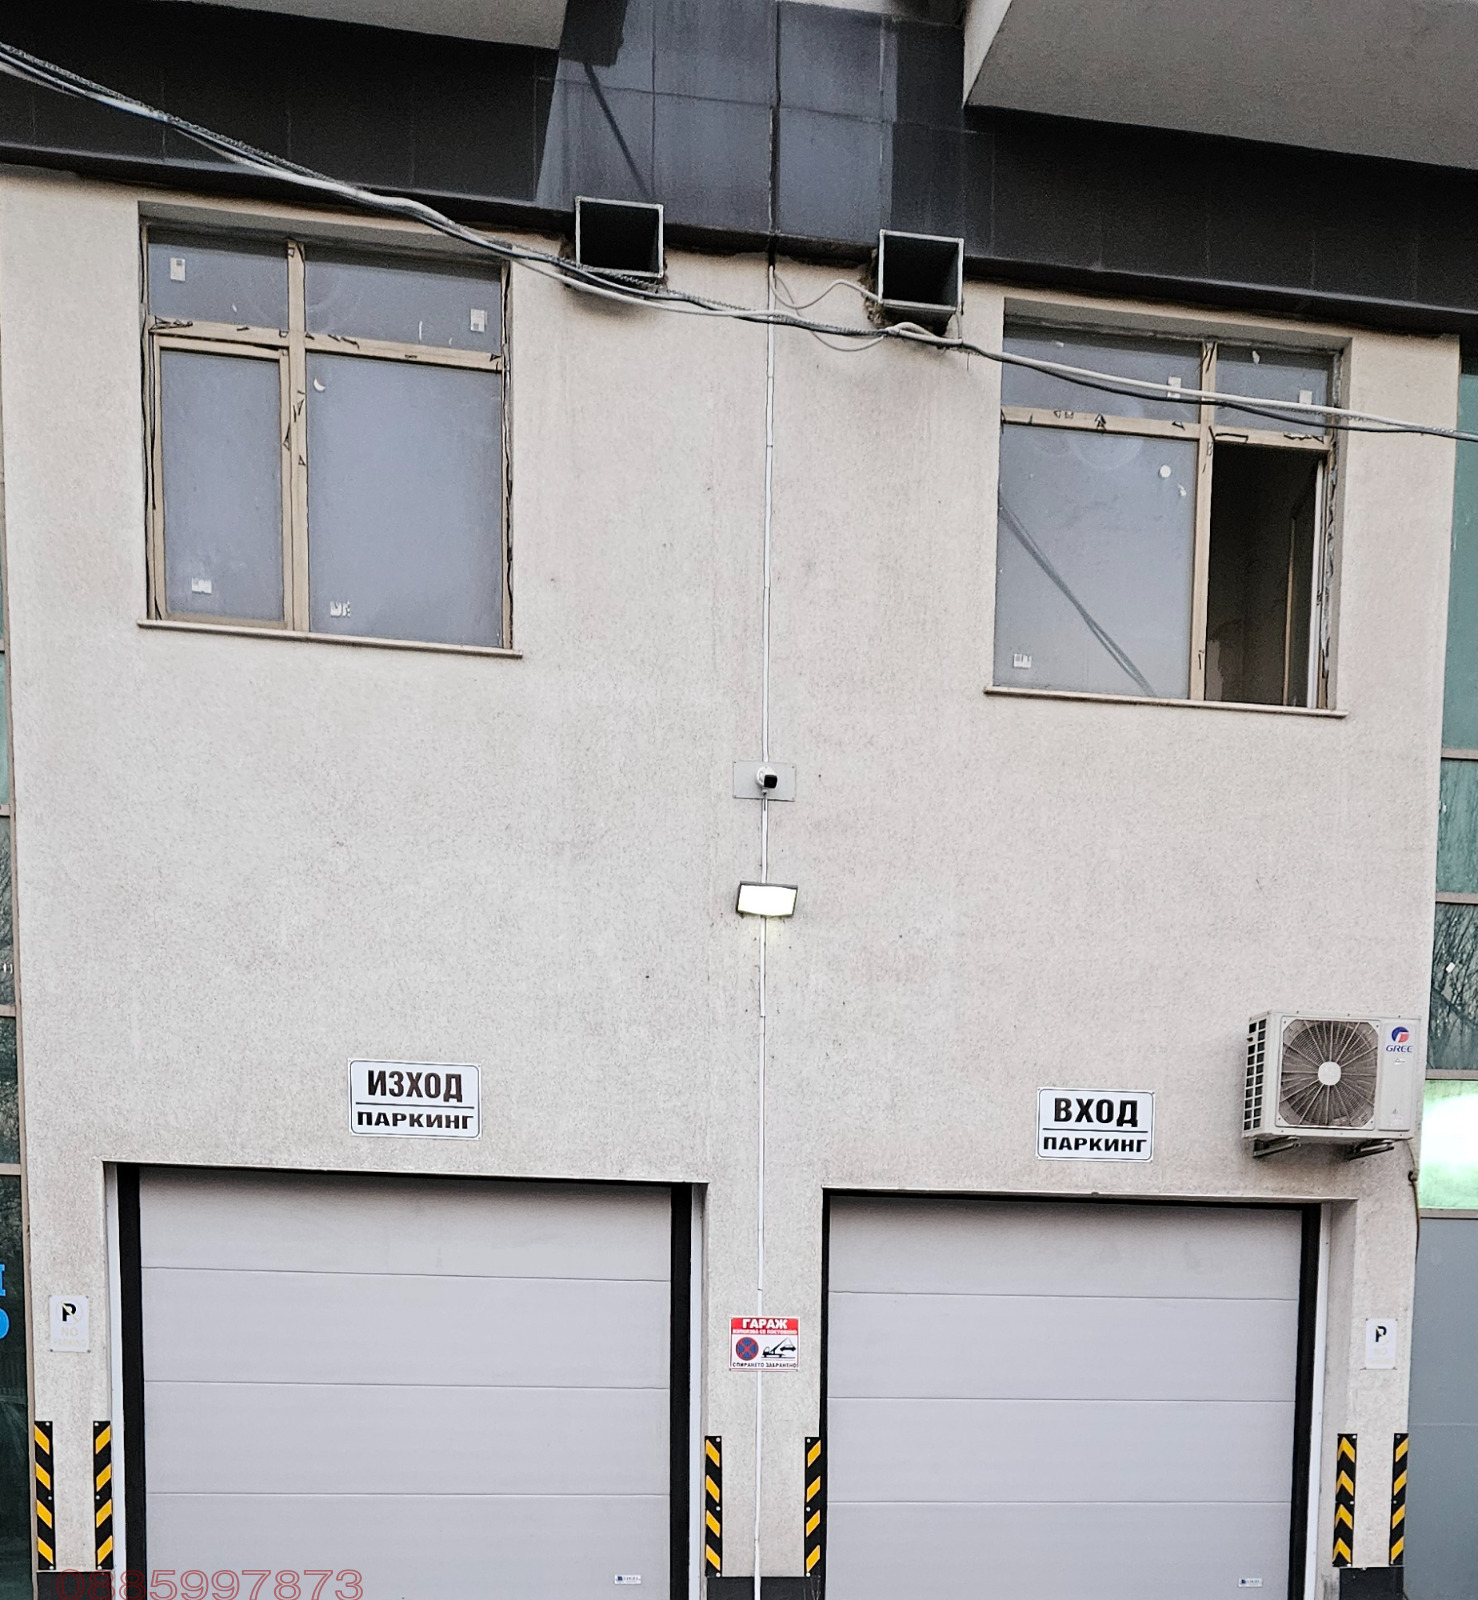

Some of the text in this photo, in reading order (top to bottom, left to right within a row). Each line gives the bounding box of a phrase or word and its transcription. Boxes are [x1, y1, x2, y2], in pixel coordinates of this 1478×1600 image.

[367, 1069, 463, 1103] ИЗХОД
[357, 1111, 474, 1130] ПАРКИНГ
[1053, 1097, 1138, 1127] ВХОД
[1043, 1136, 1147, 1152] ПАРКИНГ
[742, 1318, 788, 1329] ГАРАЖ
